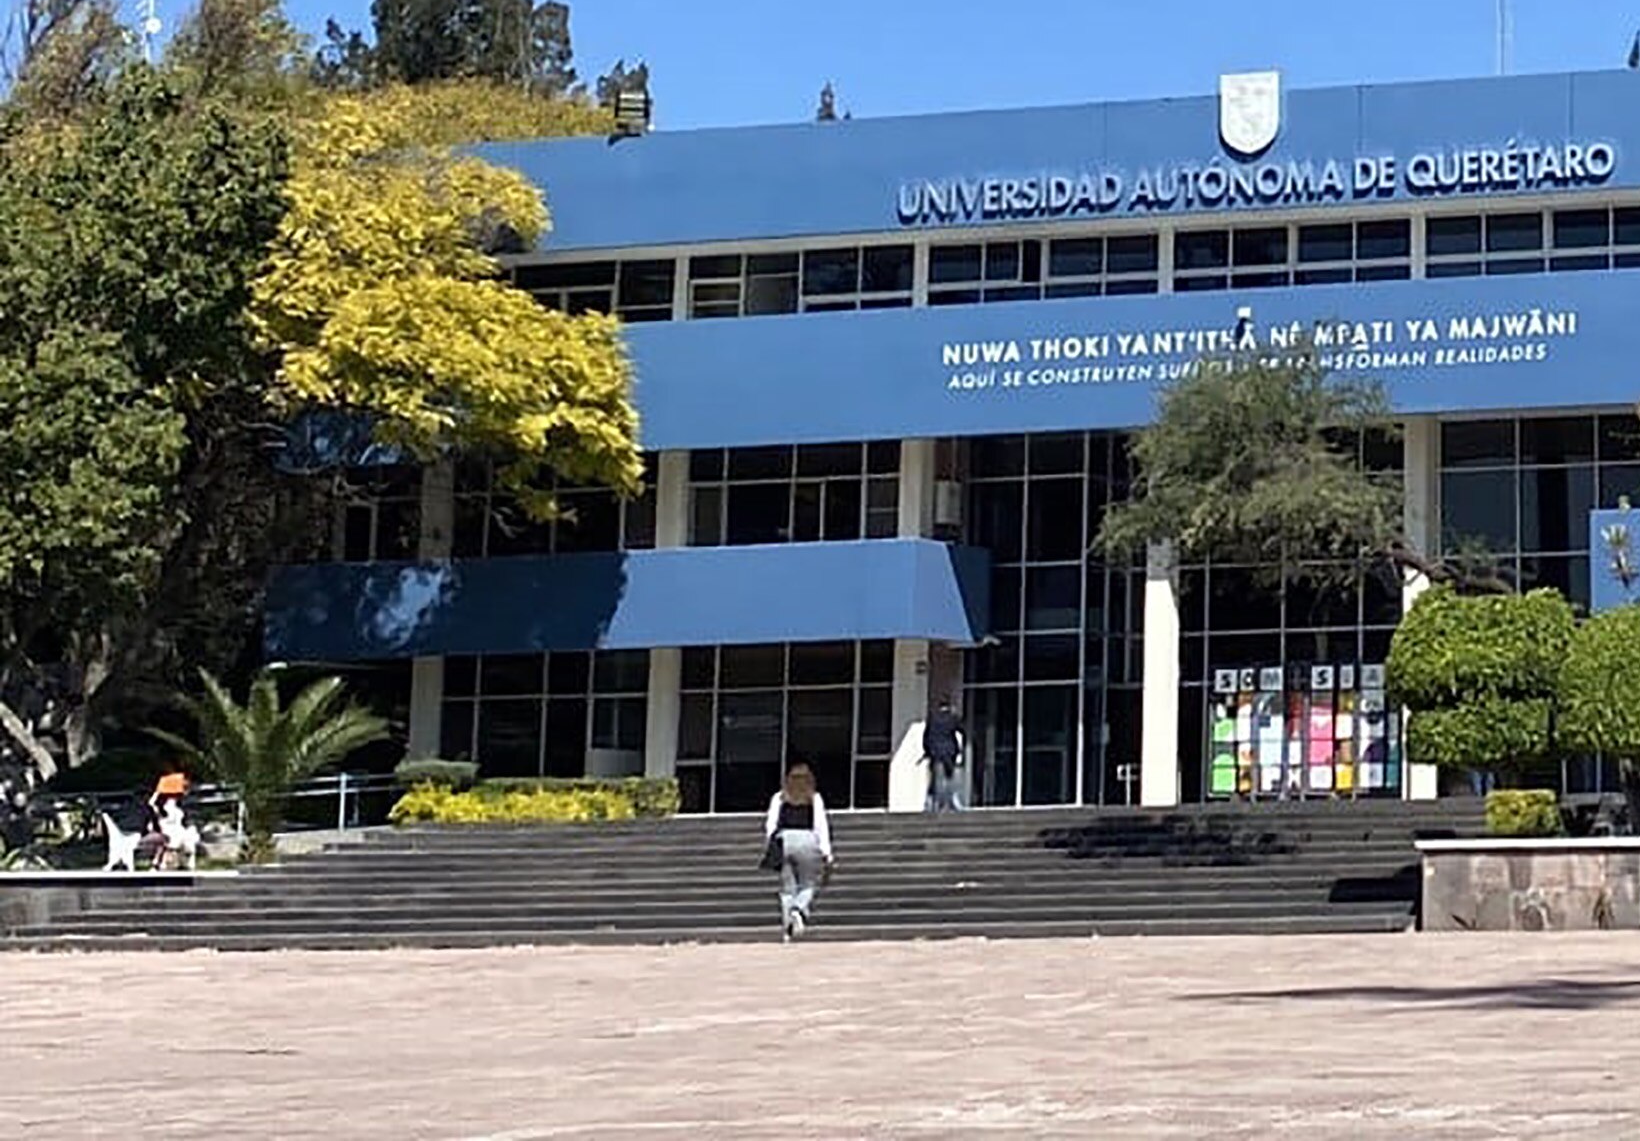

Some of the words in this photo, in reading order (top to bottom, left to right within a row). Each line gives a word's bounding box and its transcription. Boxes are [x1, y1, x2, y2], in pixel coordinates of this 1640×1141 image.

[898, 173, 1122, 218] UNIVERSIDAD
[1130, 156, 1344, 204] AUTÓNOMA
[1354, 156, 1396, 190] DE
[1406, 139, 1615, 188] QUERÉTARO
[943, 340, 1020, 365] NUWA
[1030, 335, 1109, 360] THOKI
[1406, 319, 1439, 342] YA
[948, 369, 995, 389] AQUÍ
[1002, 370, 1023, 387] SE
[1027, 363, 1153, 385] CONSTRUYEN
[1286, 351, 1427, 371] NSFORMAN
[1434, 343, 1546, 366] REALIDADES
